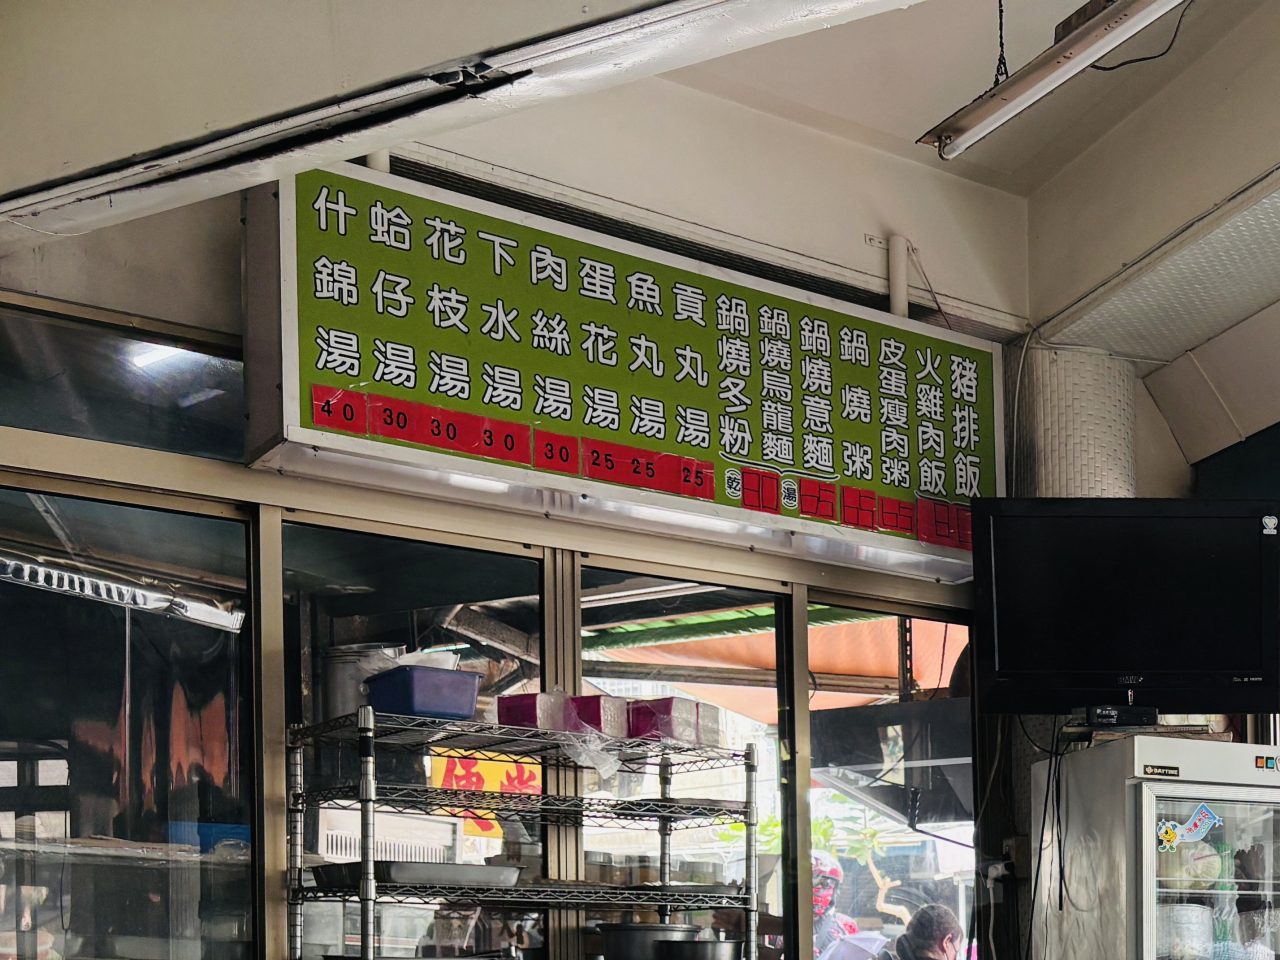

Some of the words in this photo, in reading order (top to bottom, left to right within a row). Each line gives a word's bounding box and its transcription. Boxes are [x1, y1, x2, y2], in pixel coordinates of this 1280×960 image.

[312, 186, 362, 378] 什錦湯
[368, 200, 417, 391] 蛤仔湯
[424, 216, 470, 401] 花枝湯
[477, 229, 522, 412] 下水湯
[529, 244, 573, 422] 肉絲湯
[577, 256, 620, 431] 蛋花湯
[625, 271, 666, 440] 魚丸湯
[320, 398, 356, 422] 40
[382, 407, 408, 430] 30
[430, 418, 457, 441] 30
[482, 428, 516, 451] 30
[671, 281, 711, 449] 貢丸湯
[715, 294, 753, 457] 鍋燒冬粉
[799, 315, 834, 476] 鍋燒意麵
[838, 325, 872, 481] 鍋燒粥
[877, 337, 911, 489] 皮蛋瘦肉粥
[914, 346, 947, 497] 火雞肉飯
[950, 354, 982, 499] 豬排飯
[543, 442, 570, 464] 30
[590, 449, 616, 471] 25
[631, 457, 656, 479] 25
[682, 466, 704, 488] 25
